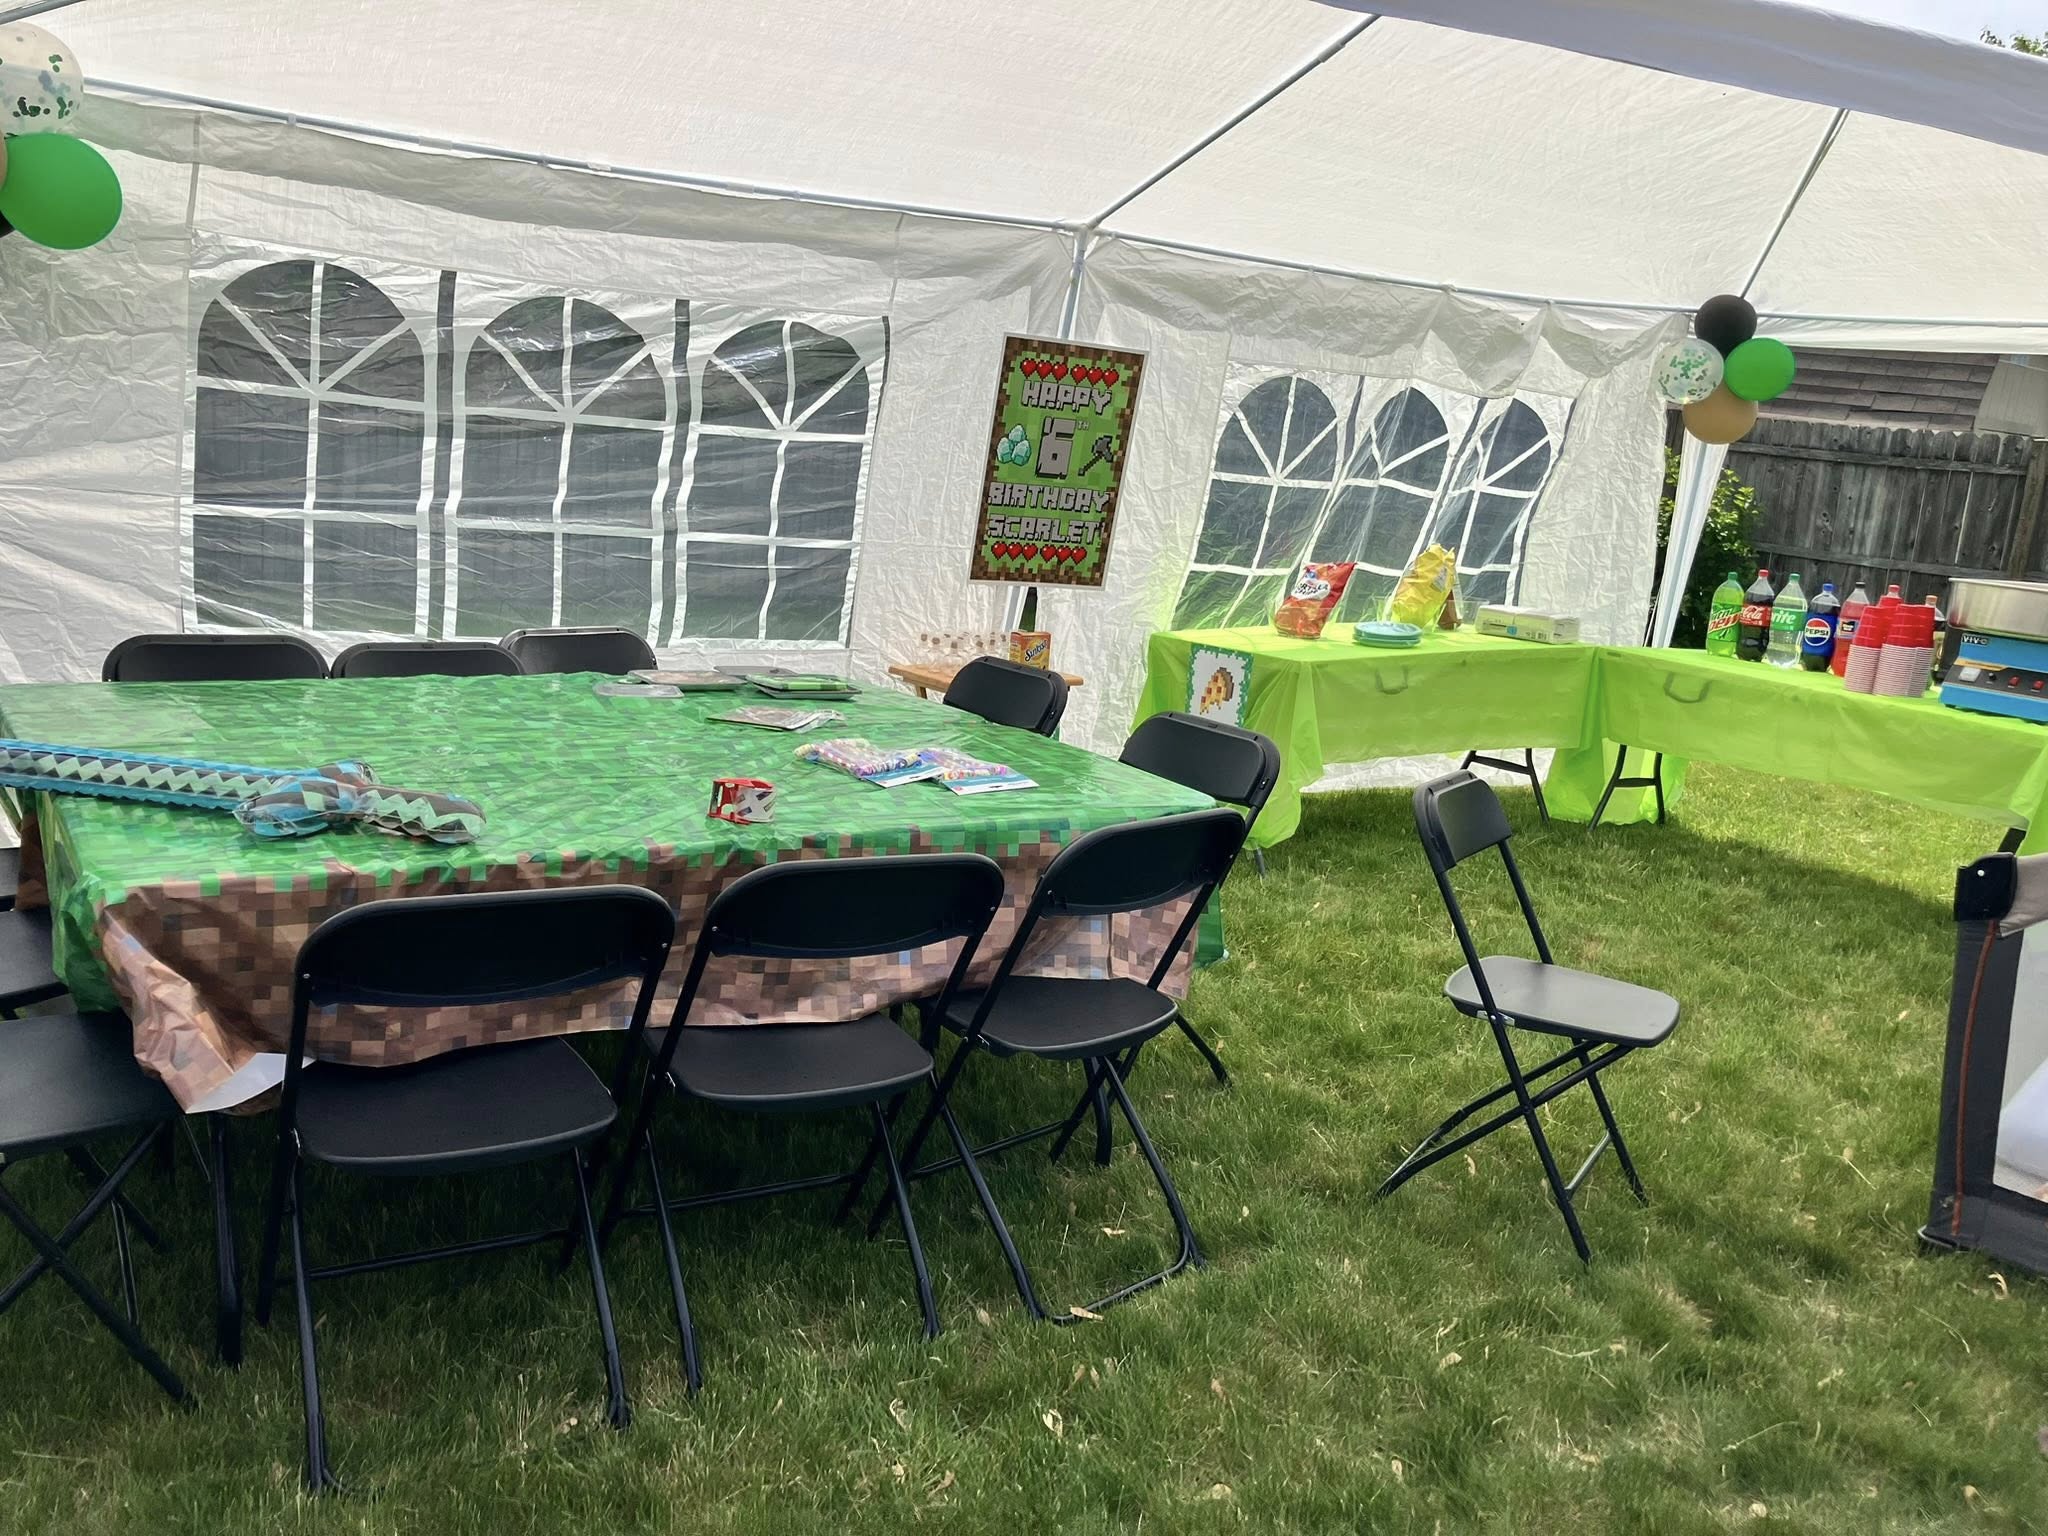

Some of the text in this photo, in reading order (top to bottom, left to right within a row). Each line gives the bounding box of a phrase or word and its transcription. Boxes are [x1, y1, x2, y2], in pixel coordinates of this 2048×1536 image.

[1021, 381, 1112, 415] HAPPY
[988, 482, 1110, 513] BIRTHDAY
[988, 514, 1100, 544] SCARLET
[1806, 627, 1829, 636] PEPSI
